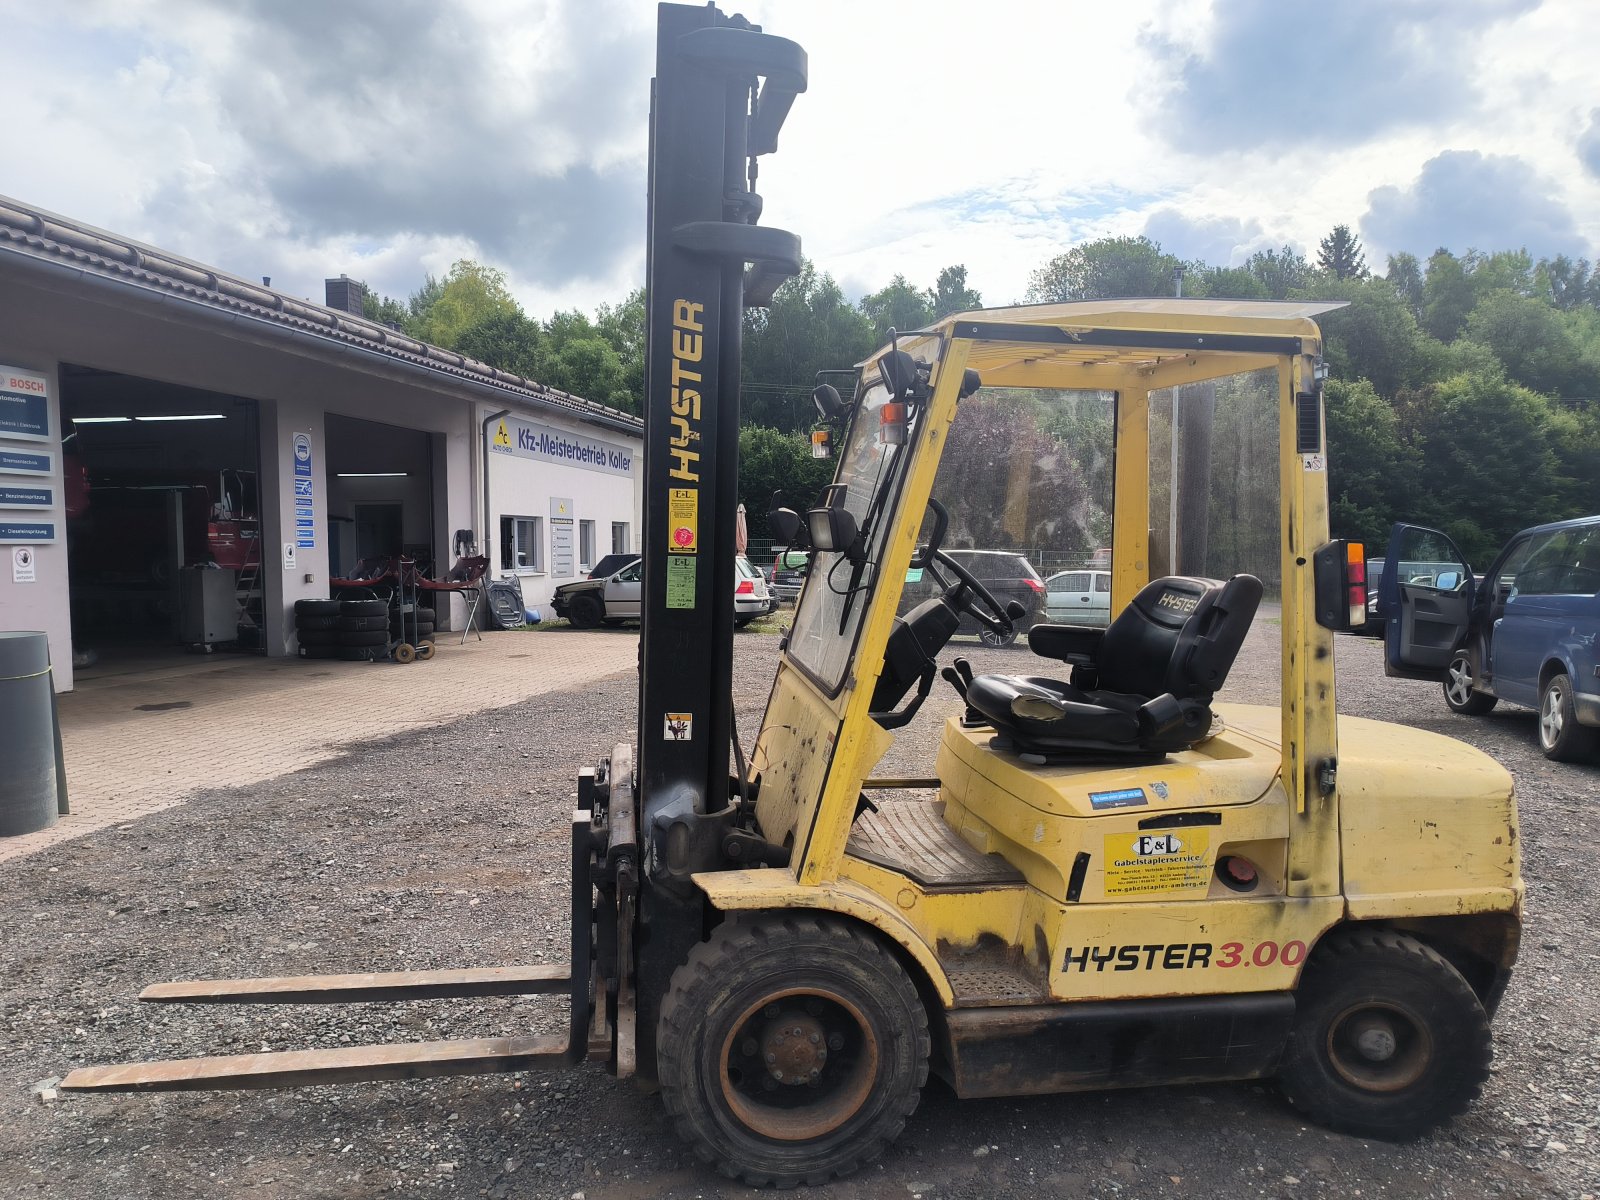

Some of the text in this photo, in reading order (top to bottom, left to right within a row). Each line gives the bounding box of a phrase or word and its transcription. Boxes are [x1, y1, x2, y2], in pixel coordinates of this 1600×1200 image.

[9, 378, 45, 392] BOSCH
[669, 298, 704, 481] HYSTER
[518, 427, 631, 471] Kfz-Meisterbetrieb Koller
[1114, 855, 1200, 867] Gabelstaplerservice
[1107, 880, 1207, 893] www.gabelstapler-amberg.de
[1062, 940, 1307, 972] HYSTER 3.00
